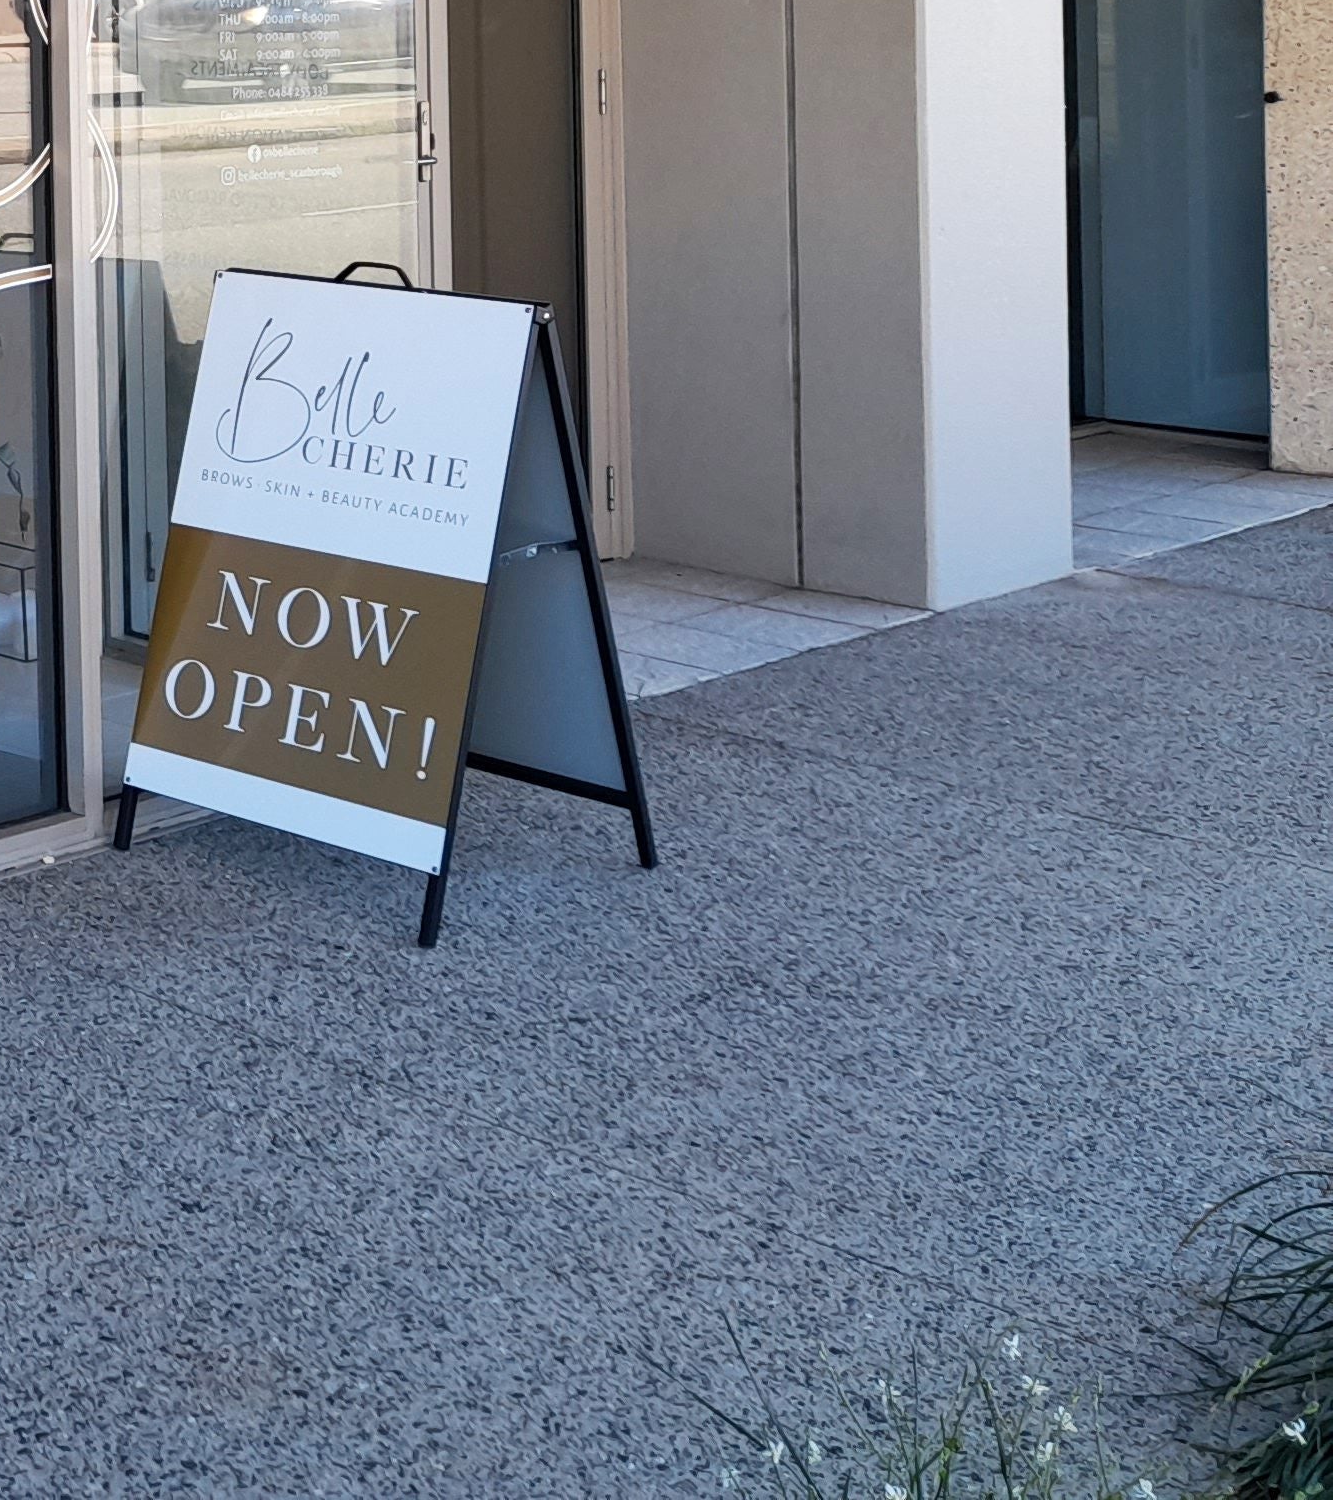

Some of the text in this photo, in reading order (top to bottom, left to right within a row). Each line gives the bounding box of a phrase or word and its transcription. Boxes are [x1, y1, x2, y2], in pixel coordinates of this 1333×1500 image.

[219, 14, 241, 26] THU
[219, 32, 236, 44] FRI
[219, 49, 238, 61] SAT
[216, 317, 396, 462] Belle
[302, 435, 469, 489] CHERIE
[201, 468, 253, 489] BROWS
[264, 479, 301, 498] SKIN
[321, 489, 383, 512] BEAUTY
[388, 502, 470, 527] ACADEMY
[206, 569, 420, 667] NOW
[164, 658, 436, 780] OPEN!
